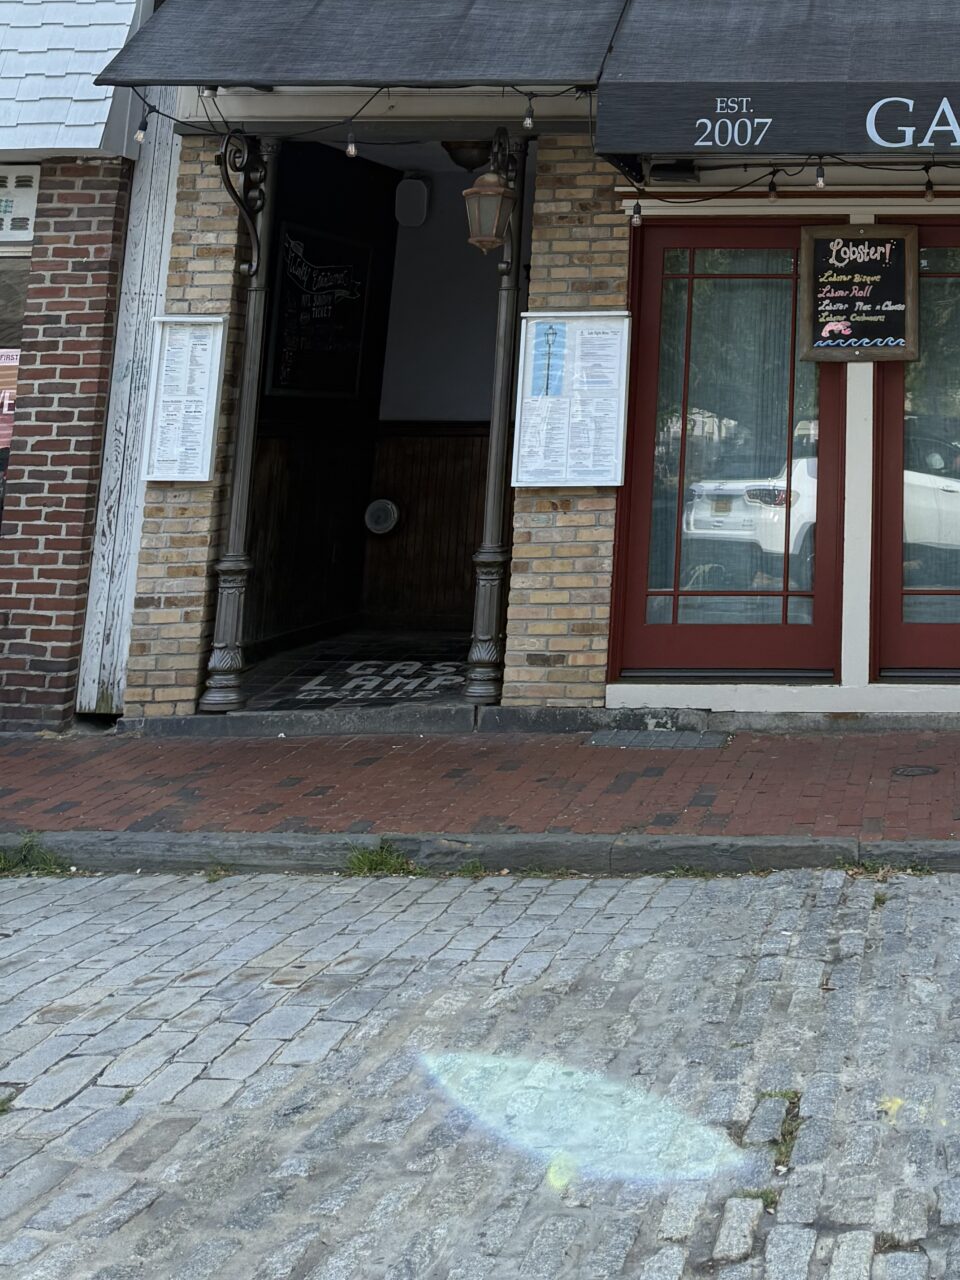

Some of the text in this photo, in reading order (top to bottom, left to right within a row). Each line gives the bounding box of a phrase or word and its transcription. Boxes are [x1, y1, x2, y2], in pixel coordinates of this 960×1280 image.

[715, 97, 754, 113] EST.
[694, 118, 773, 147] 2007
[829, 239, 891, 268] Lobster!
[850, 285, 873, 297] Roll
[346, 660, 464, 675] GAS
[300, 675, 466, 690] LAMP
[295, 690, 440, 699] GRILLE
